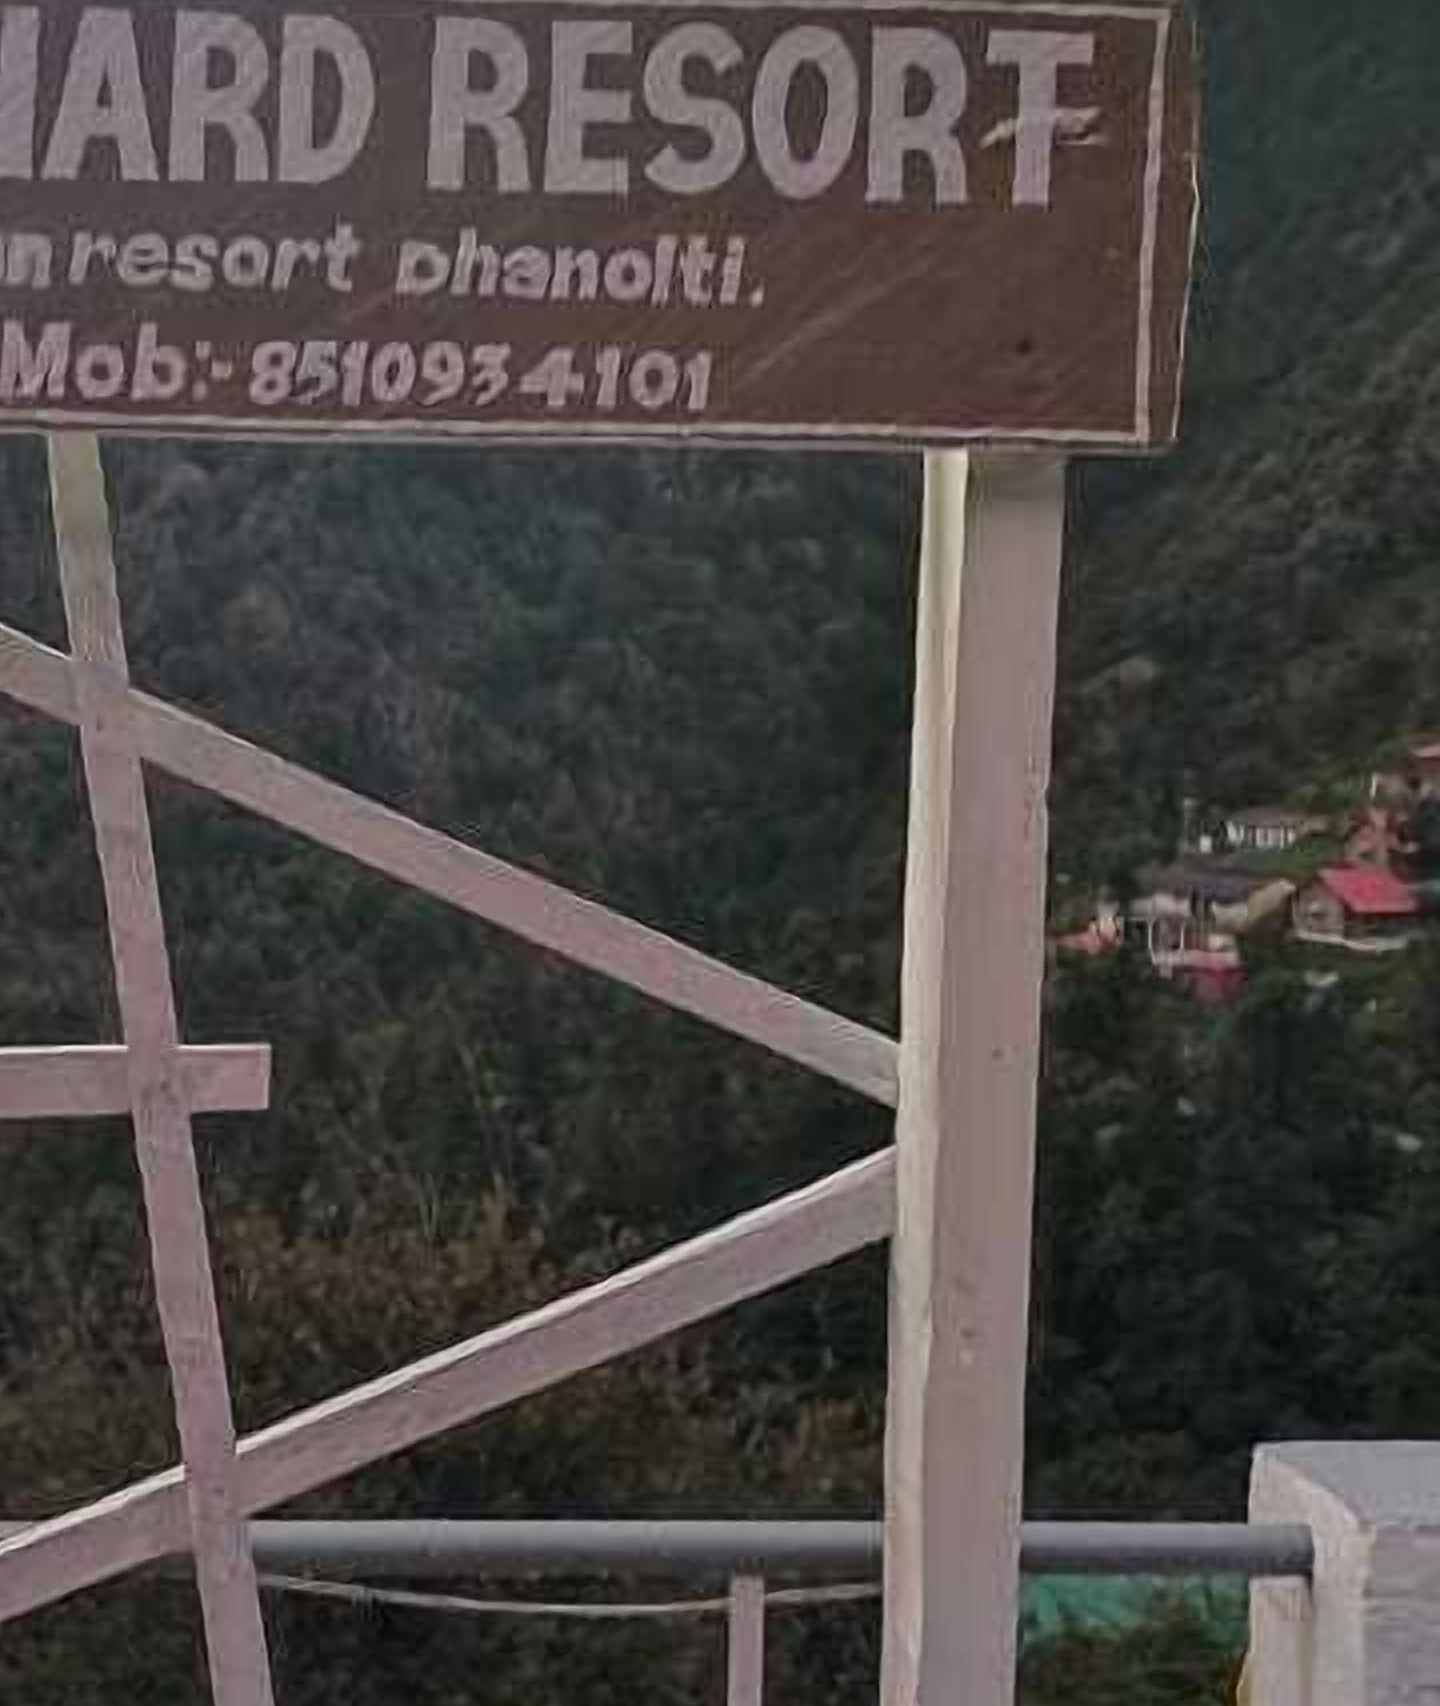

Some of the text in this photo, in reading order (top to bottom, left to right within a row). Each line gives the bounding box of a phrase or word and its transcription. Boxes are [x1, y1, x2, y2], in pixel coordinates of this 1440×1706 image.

[426, 15, 1106, 207] RESORT
[69, 223, 358, 292] resort
[249, 341, 711, 410] 8510934101
